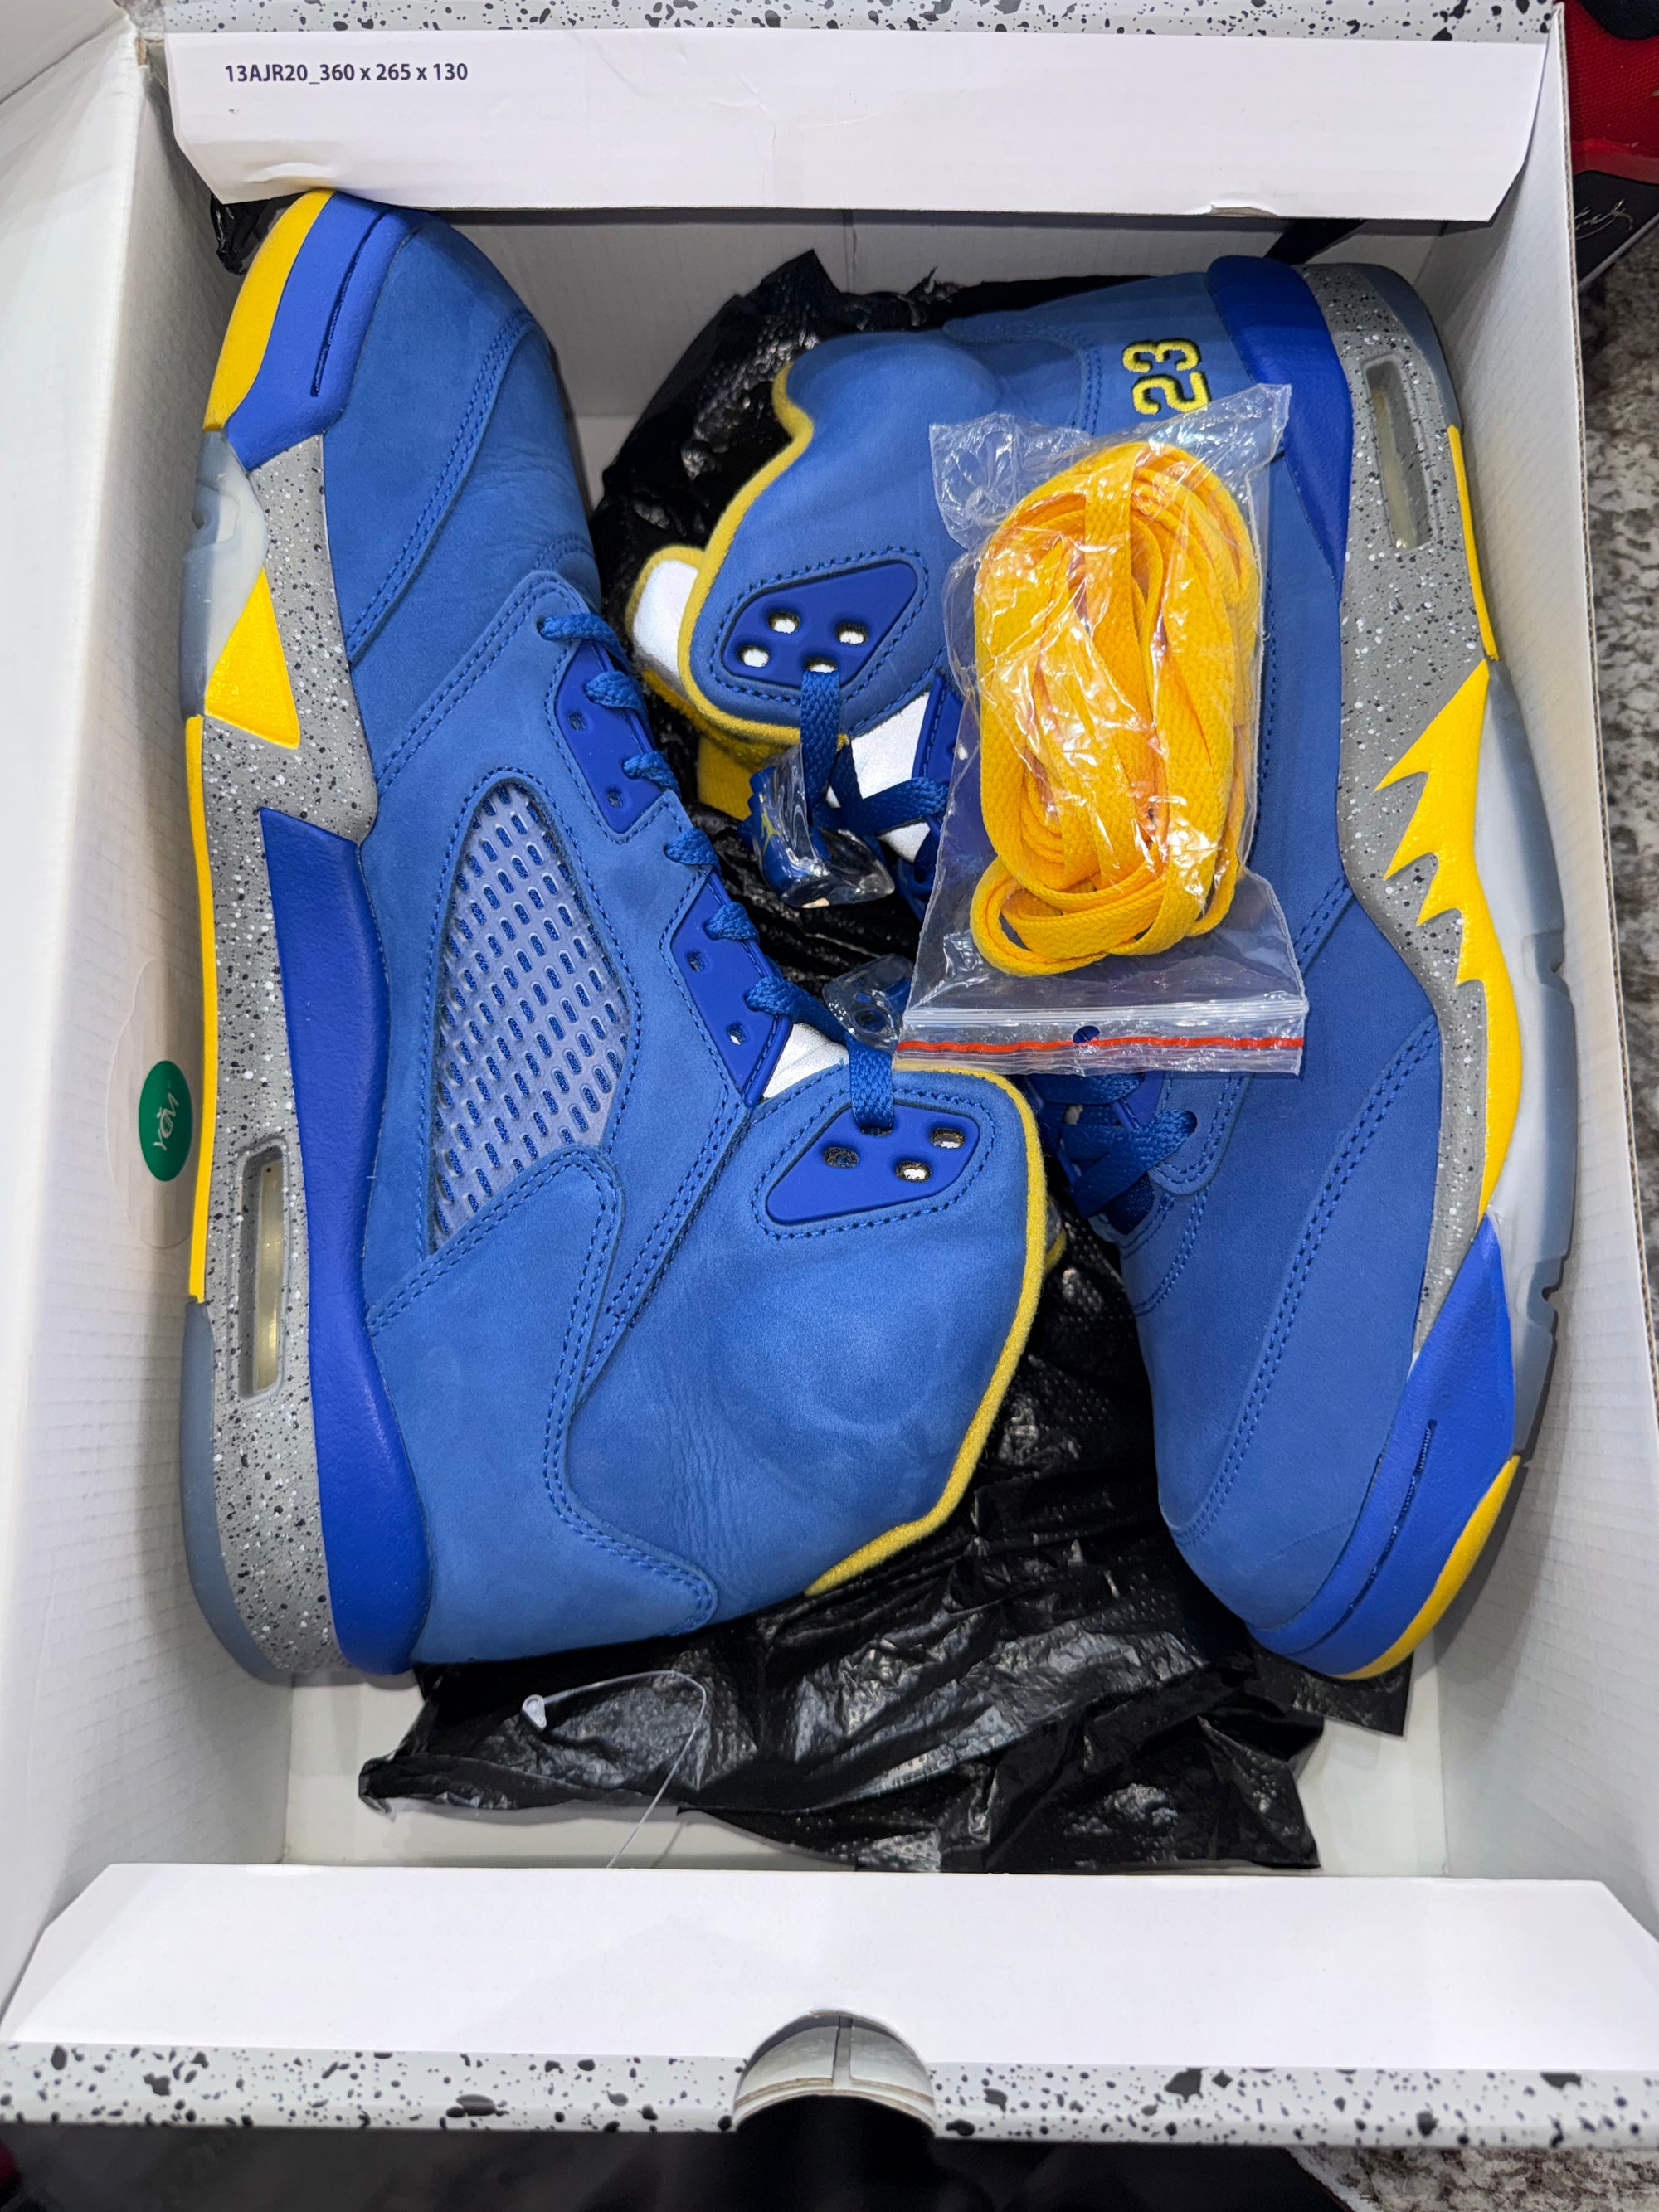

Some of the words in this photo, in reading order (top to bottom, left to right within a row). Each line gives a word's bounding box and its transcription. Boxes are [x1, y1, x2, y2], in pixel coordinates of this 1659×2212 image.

[225, 64, 356, 85] 13AJR20_360
[360, 66, 371, 81] x
[376, 63, 411, 81] 265
[416, 66, 428, 81] x
[433, 63, 468, 81] 130
[1122, 338, 1211, 415] 23
